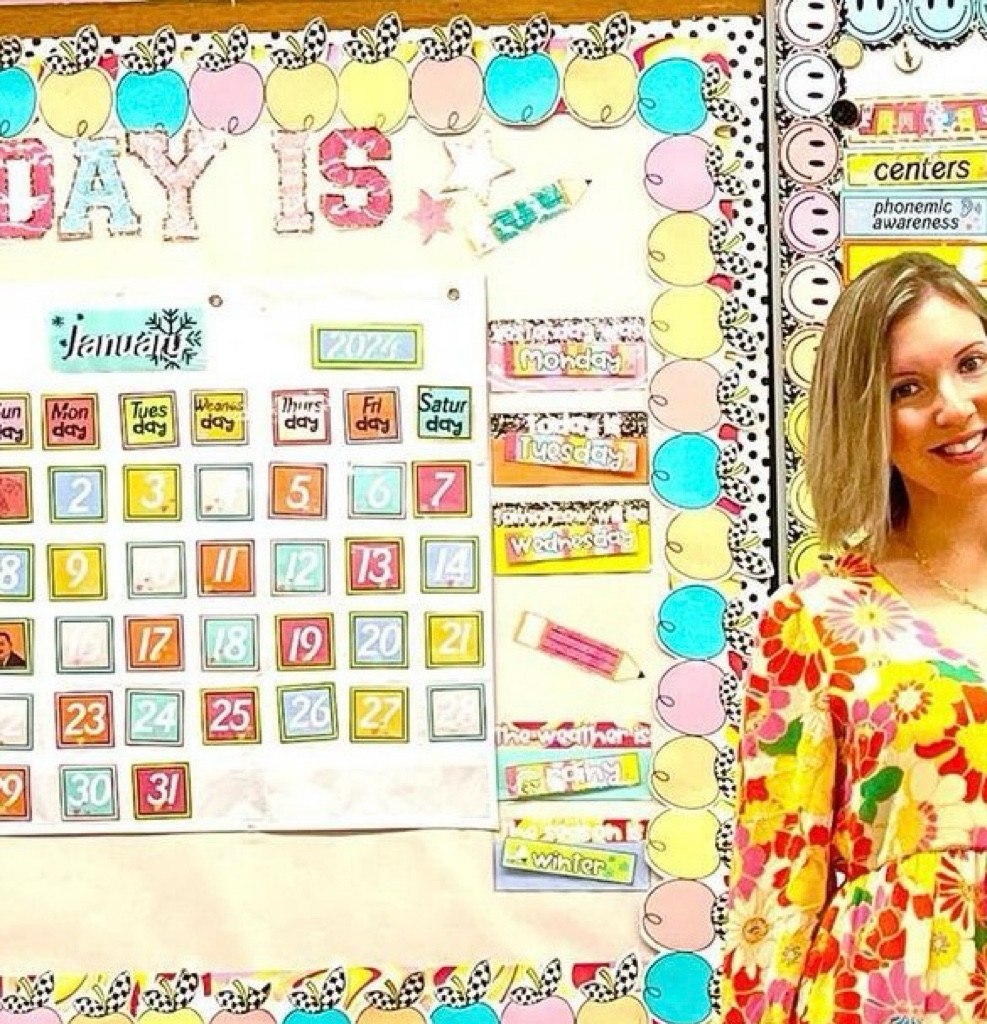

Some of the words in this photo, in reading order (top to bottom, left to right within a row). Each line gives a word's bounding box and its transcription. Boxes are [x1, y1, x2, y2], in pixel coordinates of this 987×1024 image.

[272, 127, 393, 234] IS
[874, 157, 971, 181] centers
[872, 216, 959, 231] awareness
[873, 197, 953, 217] phonemic
[518, 347, 624, 375] Monday
[0, 401, 21, 420] un
[51, 402, 88, 421] Mon
[131, 400, 168, 420] Tues
[362, 396, 382, 415] Fri
[418, 392, 468, 414] Satur
[52, 421, 87, 440] day
[132, 419, 167, 438] day
[200, 413, 235, 433] day
[284, 415, 319, 433] day
[355, 417, 391, 434] day
[426, 415, 464, 436] day
[519, 434, 625, 472] Tuesday
[69, 477, 92, 513] 2
[140, 473, 165, 508] 3
[286, 474, 312, 509] 5
[367, 473, 390, 509] 6
[430, 471, 456, 507] 7
[0, 553, 21, 591] 8
[66, 551, 90, 588] 9
[213, 547, 238, 583] 11
[285, 550, 318, 585] 12
[357, 547, 392, 584] 13
[434, 546, 469, 582] 14
[138, 626, 173, 661] 17
[214, 625, 249, 660] 18
[288, 625, 323, 663] 19
[357, 622, 401, 659] 20
[438, 620, 473, 656] 21
[64, 702, 107, 737] 23
[133, 700, 178, 734] 24
[210, 698, 252, 733] 25
[290, 694, 330, 729] 26
[359, 695, 402, 733] 27
[537, 722, 630, 747] weather
[0, 773, 23, 808] 9
[68, 773, 112, 806] 30
[146, 772, 181, 807] 31
[531, 850, 605, 876] winter
